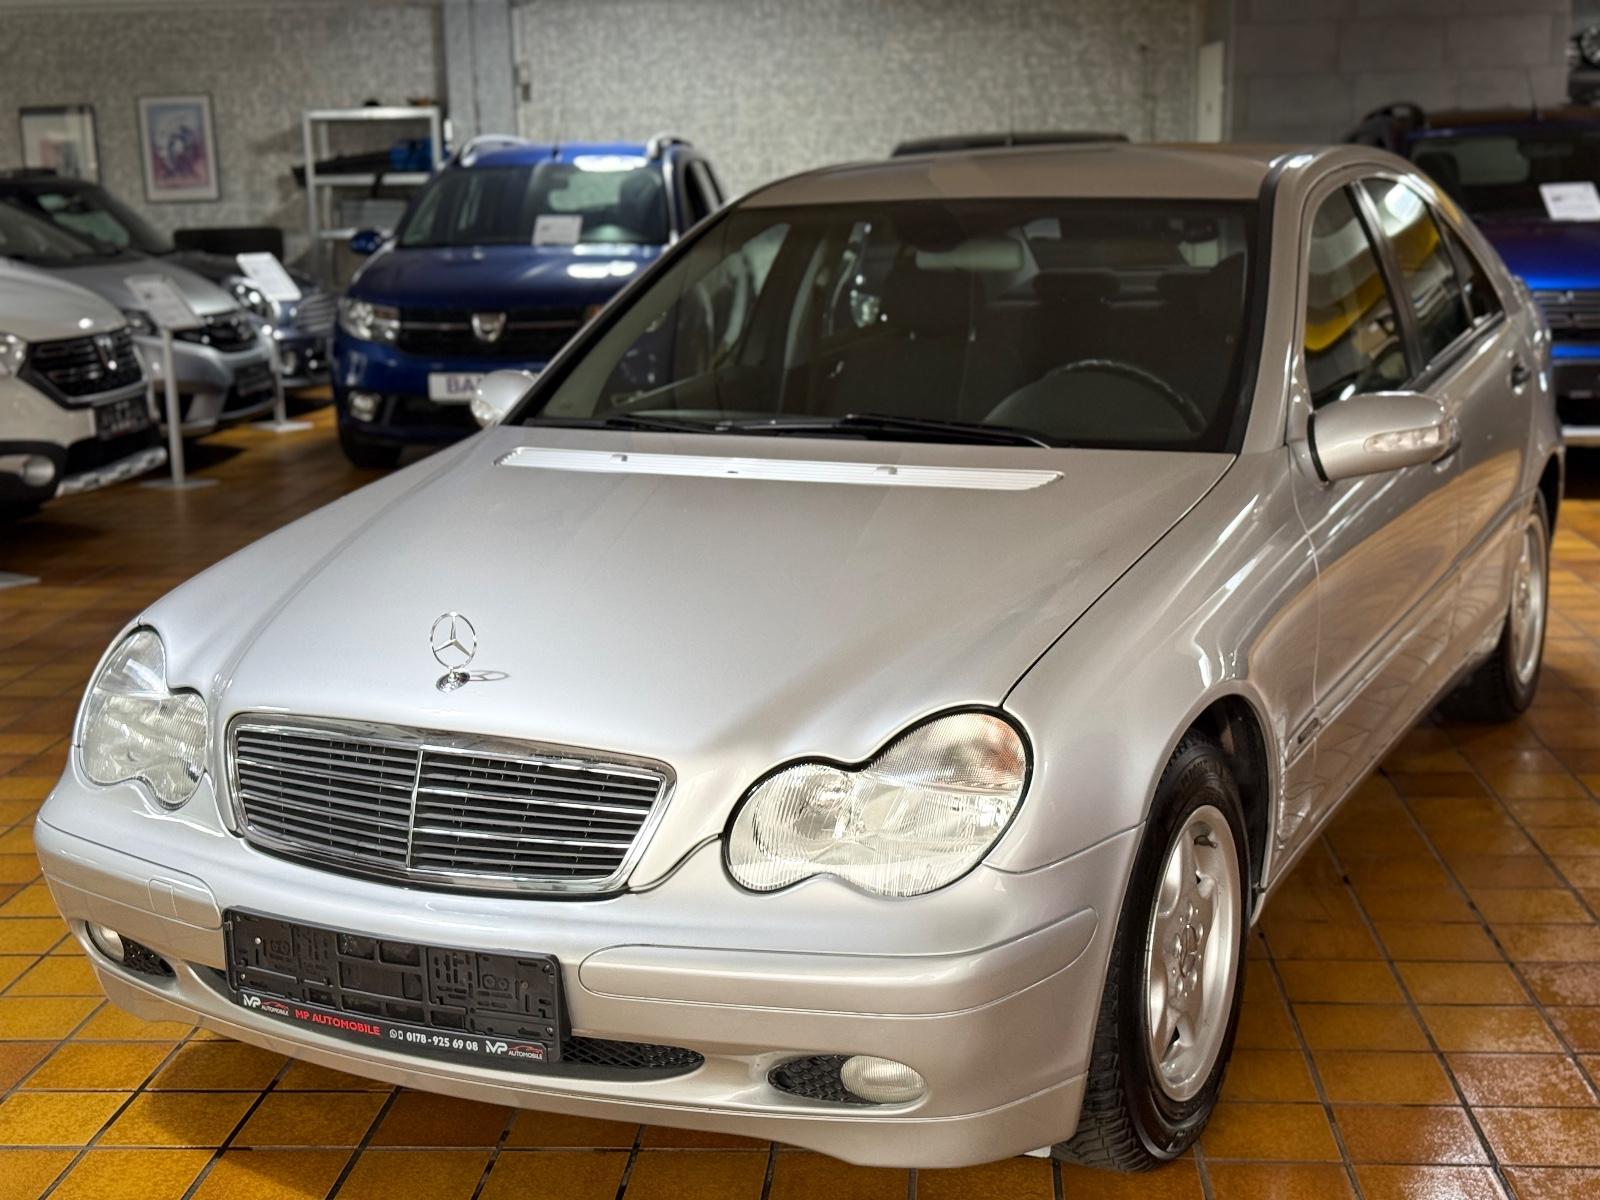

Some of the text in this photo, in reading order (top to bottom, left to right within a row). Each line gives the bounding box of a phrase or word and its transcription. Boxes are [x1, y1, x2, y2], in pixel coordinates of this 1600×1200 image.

[295, 1009, 381, 1035] MP AUTOMOBILE
[452, 1038, 464, 1050] 69
[466, 1040, 479, 1051] 08
[508, 1050, 543, 1060] AUTOMOBILE
